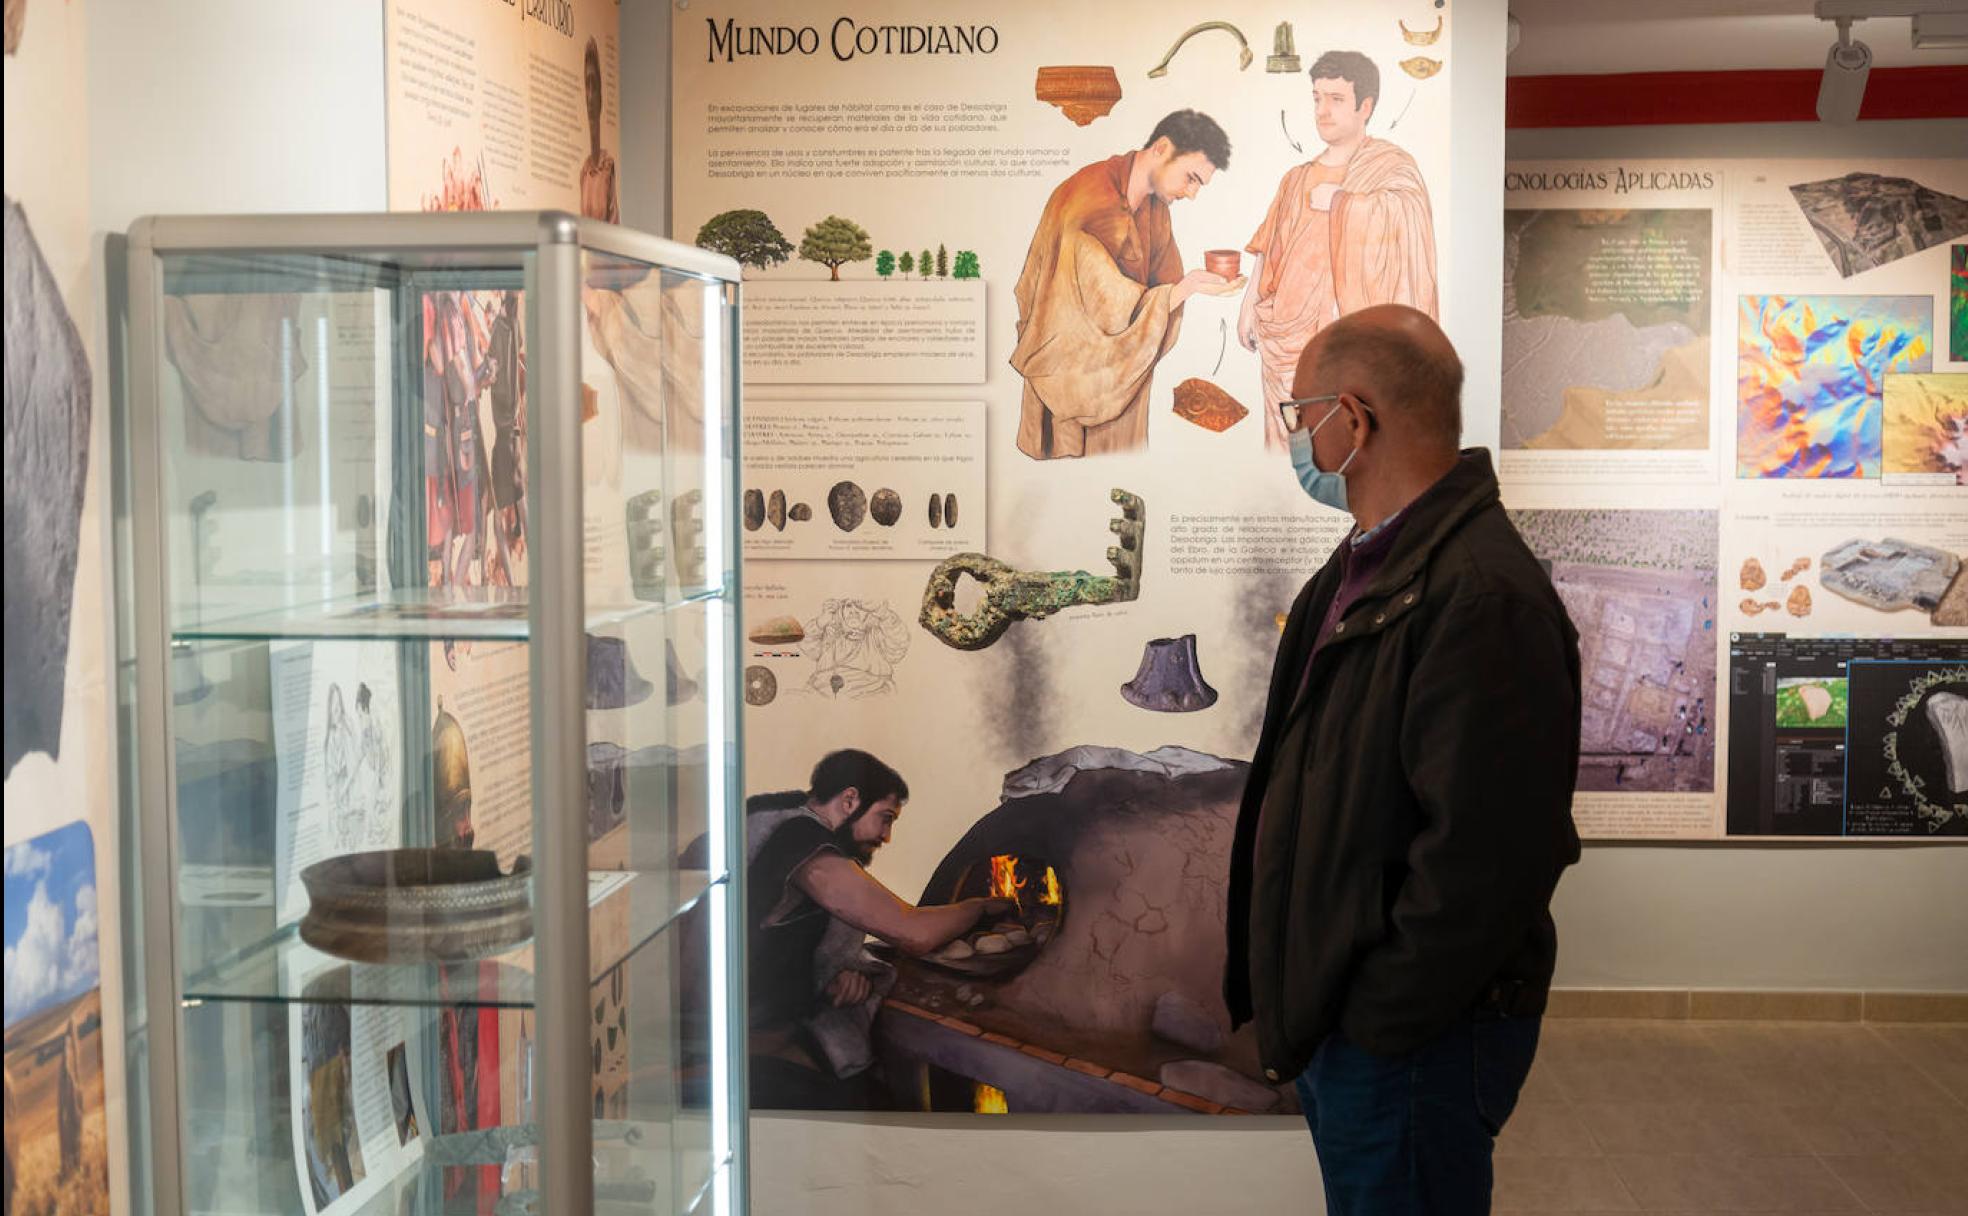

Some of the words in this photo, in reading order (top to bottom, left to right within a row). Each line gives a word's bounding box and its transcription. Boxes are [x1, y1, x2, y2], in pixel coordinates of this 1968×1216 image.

[706, 17, 819, 62] MUNDO
[831, 17, 999, 62] COTIDIANO
[1614, 167, 1714, 194] APLICADAS
